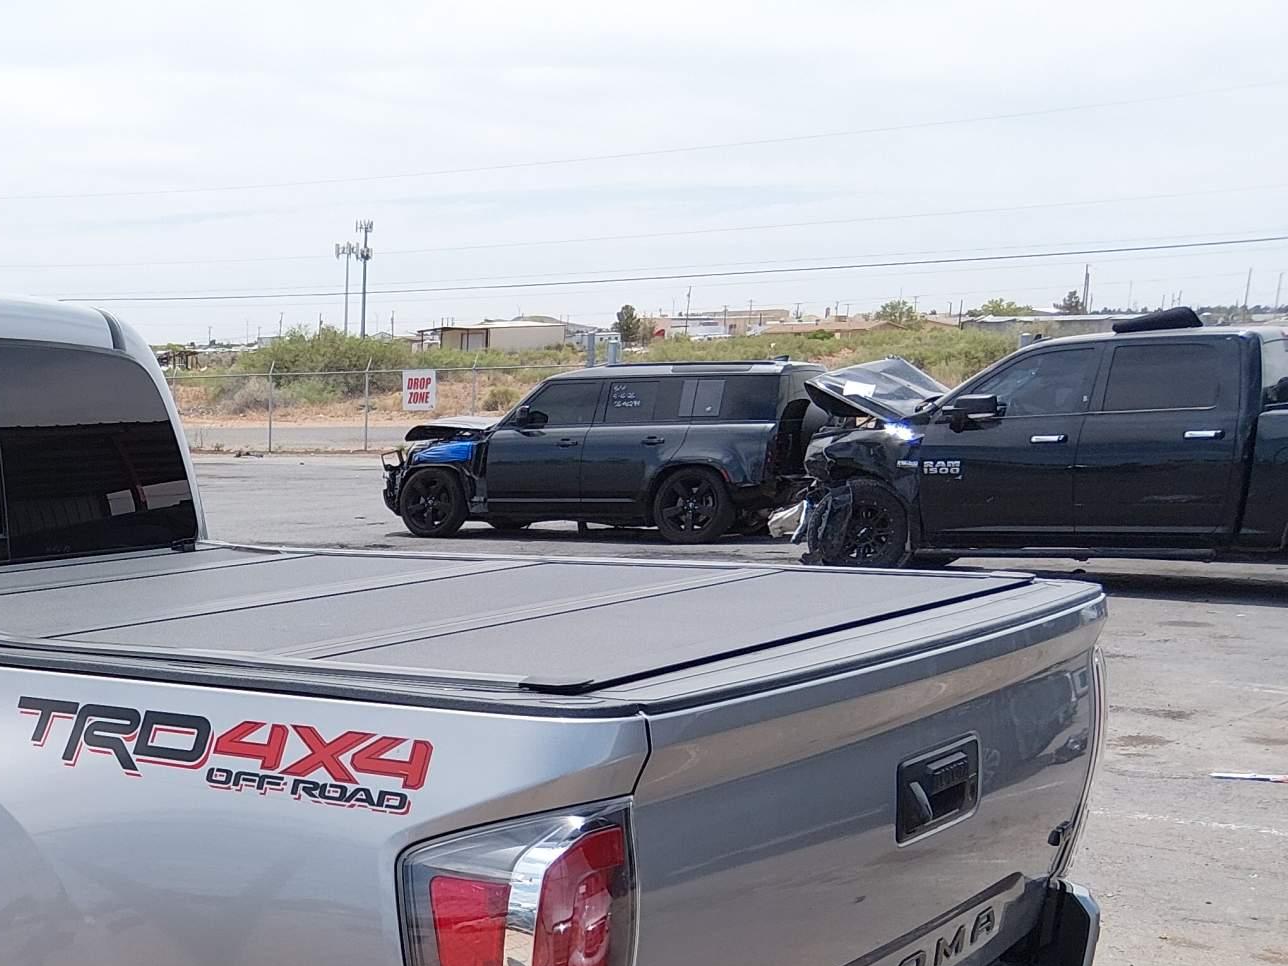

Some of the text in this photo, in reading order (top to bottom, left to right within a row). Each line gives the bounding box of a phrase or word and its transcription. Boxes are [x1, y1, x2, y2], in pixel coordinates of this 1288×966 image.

[407, 377, 432, 390] DROP
[407, 391, 430, 404] ZONE
[923, 460, 961, 468] RAM
[923, 467, 960, 475] 1500
[17, 696, 214, 777] TRD
[206, 767, 412, 816] OFF ROAD
